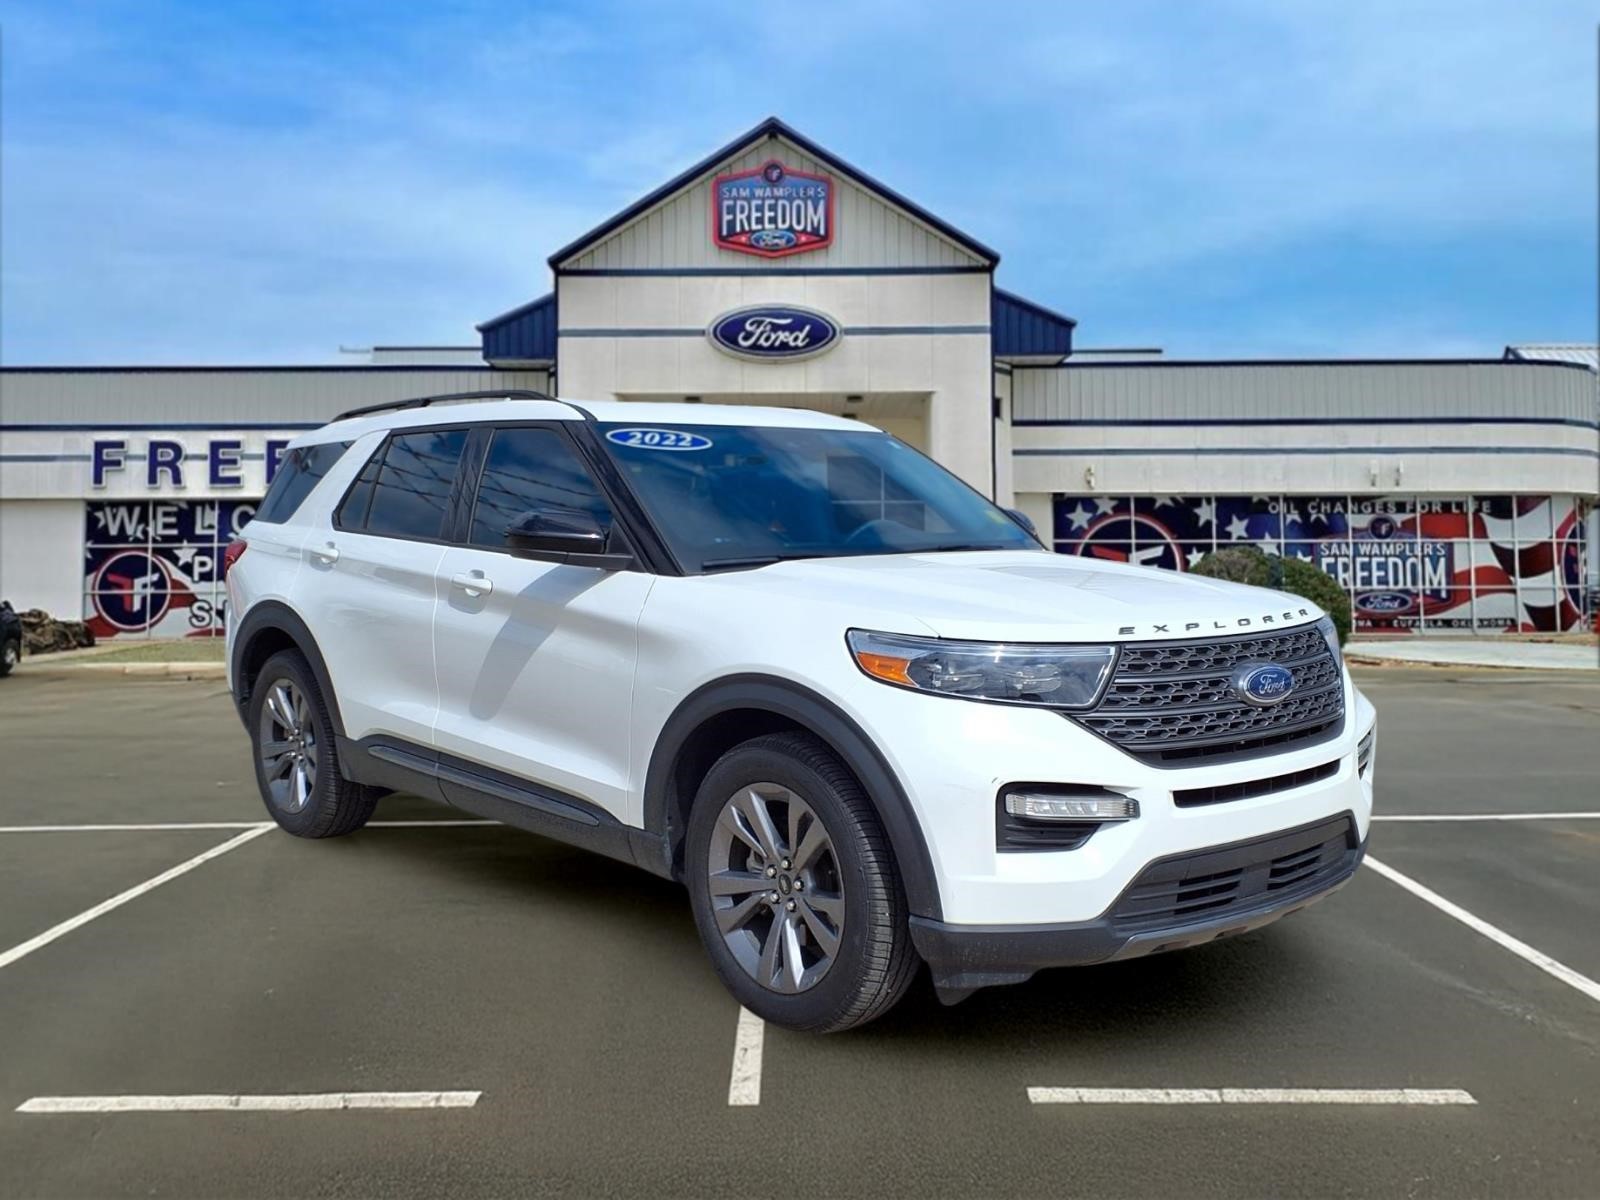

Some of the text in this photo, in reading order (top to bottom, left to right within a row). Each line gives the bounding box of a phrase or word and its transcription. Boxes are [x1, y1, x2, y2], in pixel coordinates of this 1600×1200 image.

[723, 187, 750, 198] SAM
[722, 199, 825, 236] FREEDOM
[737, 316, 812, 347] Ford
[626, 431, 692, 446] 2022
[1268, 501, 1492, 514] OIL CHANGES FOR LIFE
[1365, 594, 1400, 608] Ford
[1117, 608, 1309, 635] EXPLORER
[1259, 673, 1286, 694] Ford
